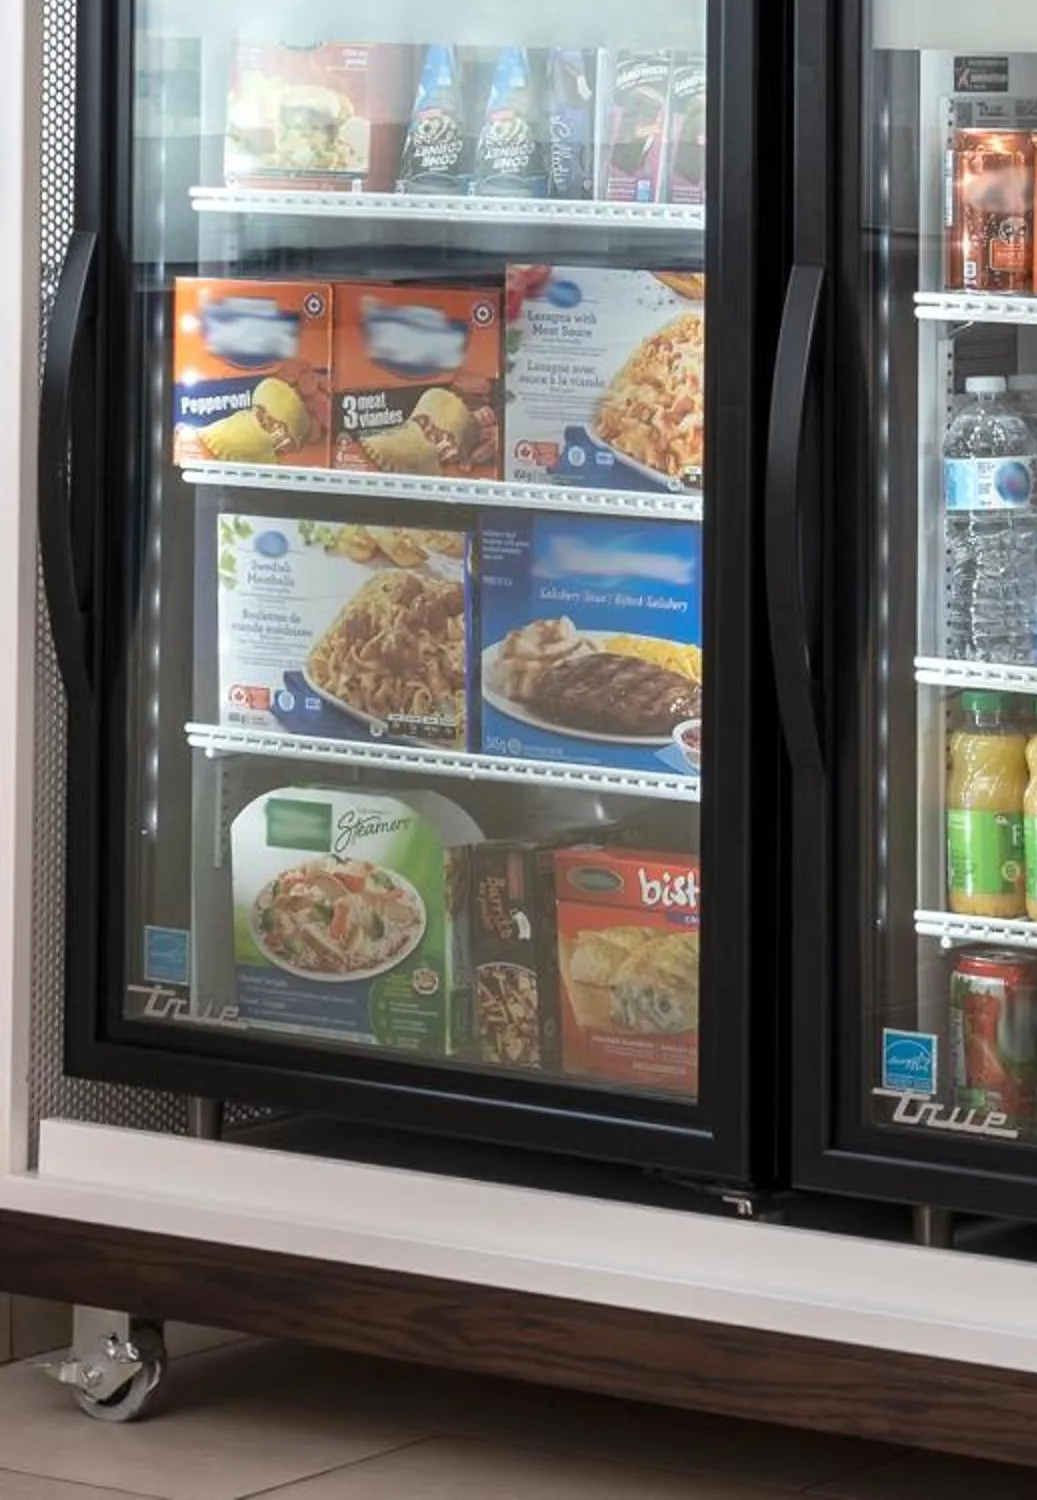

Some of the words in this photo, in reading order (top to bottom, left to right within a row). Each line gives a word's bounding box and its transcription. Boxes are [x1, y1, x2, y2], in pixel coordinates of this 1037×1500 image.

[180, 390, 251, 416] Pepperoni
[342, 395, 358, 430] 3
[357, 392, 386, 410] meat
[359, 409, 404, 429] viandes
[637, 866, 700, 909] bist
[871, 1086, 1020, 1140] True
